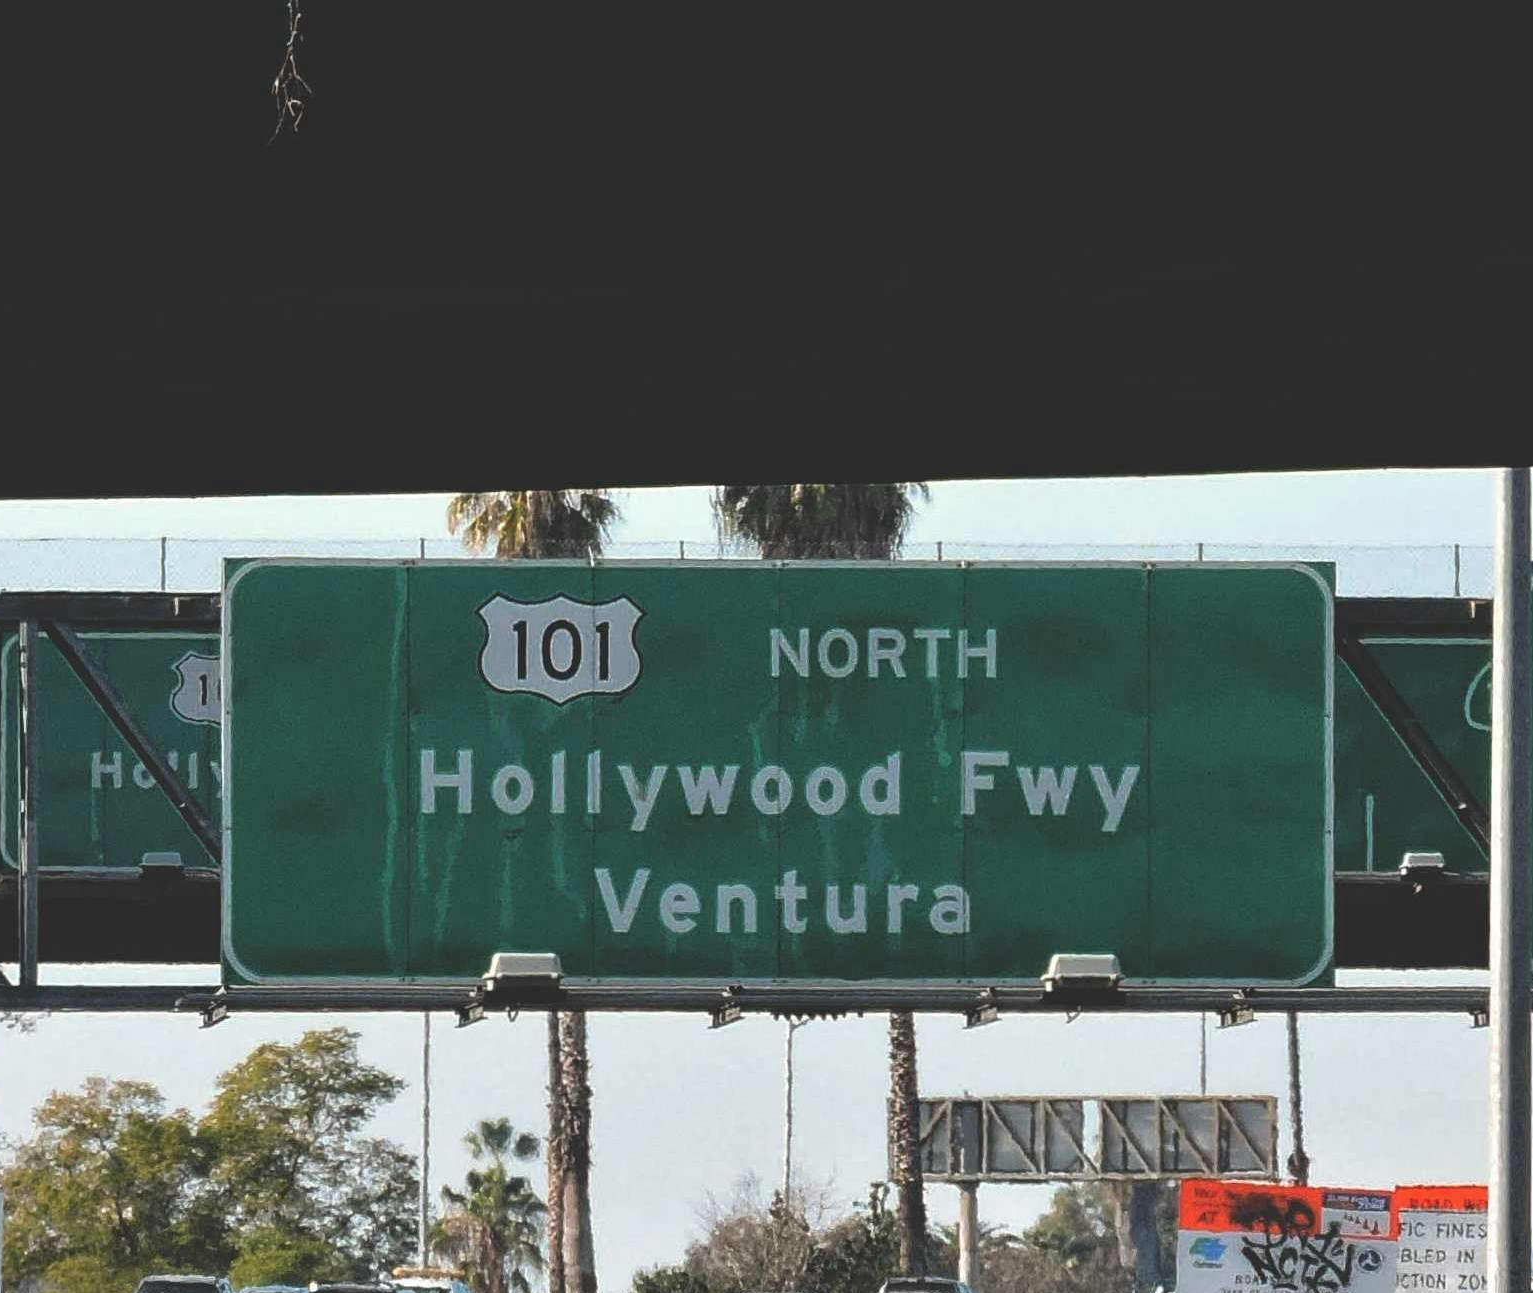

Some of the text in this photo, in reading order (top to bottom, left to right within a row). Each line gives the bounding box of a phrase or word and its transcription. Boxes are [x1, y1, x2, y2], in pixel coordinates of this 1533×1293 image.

[511, 618, 612, 681] 101
[769, 627, 998, 678] NORTH
[199, 674, 222, 706] 1
[418, 748, 1141, 833] Hollywood Fwy
[593, 867, 971, 934] Ventura
[1436, 1221, 1487, 1239] FINES
[1457, 1249, 1475, 1263] IN
